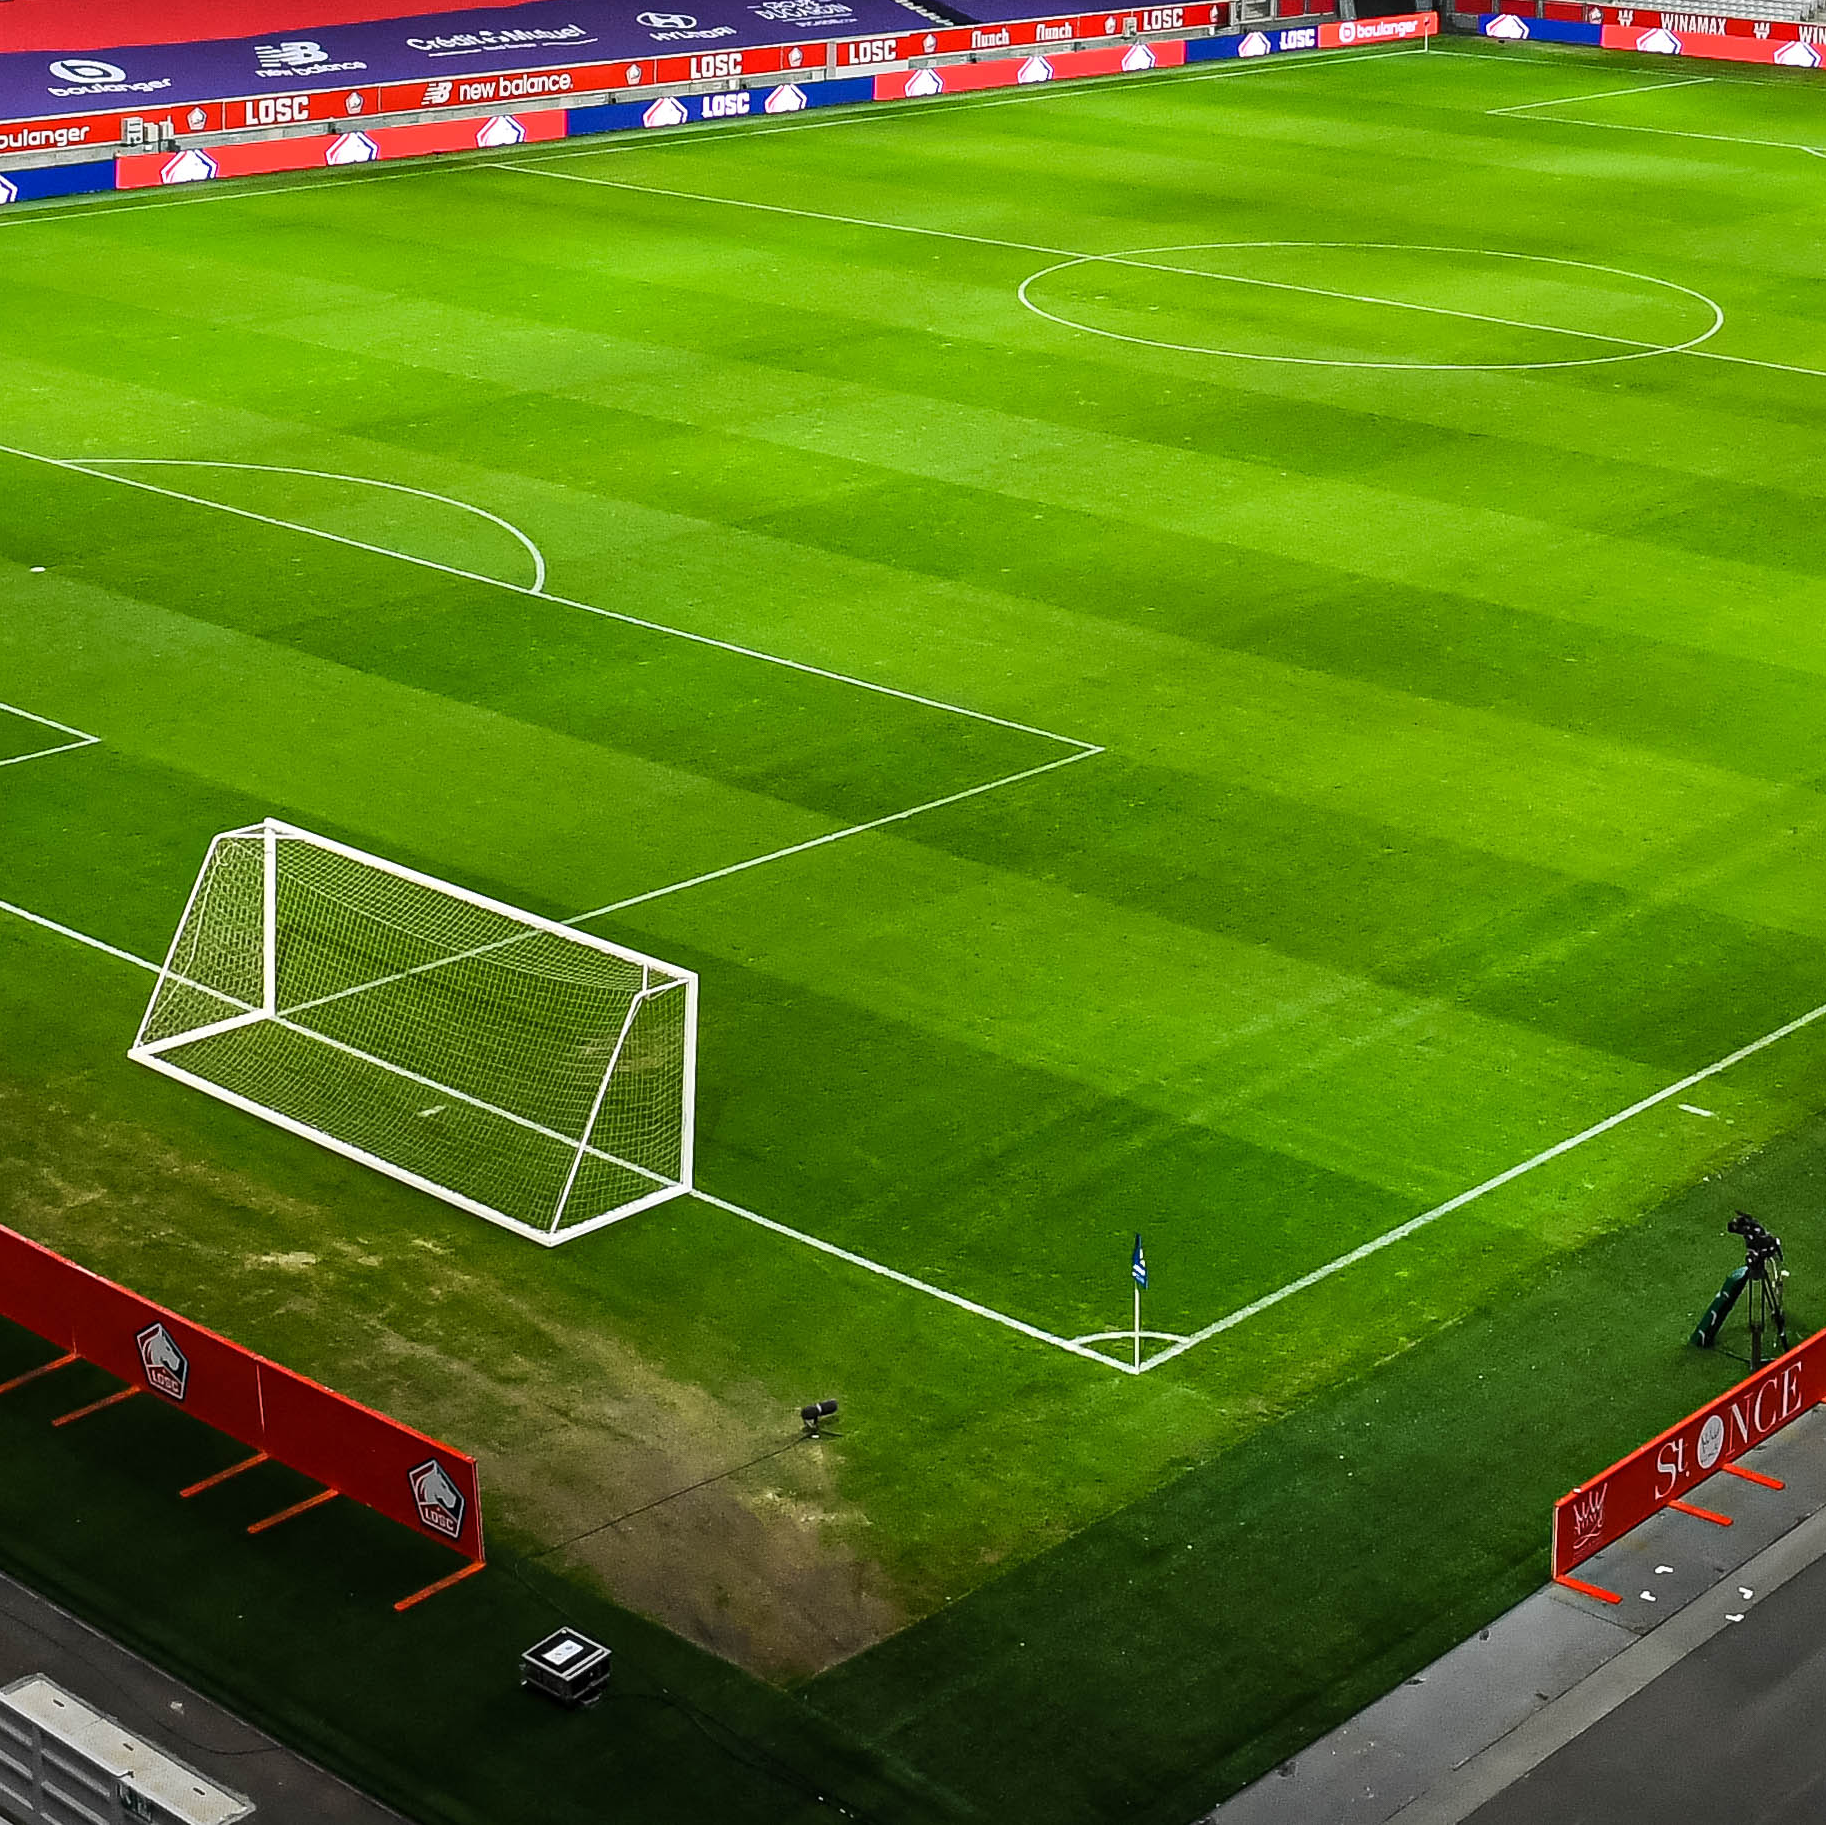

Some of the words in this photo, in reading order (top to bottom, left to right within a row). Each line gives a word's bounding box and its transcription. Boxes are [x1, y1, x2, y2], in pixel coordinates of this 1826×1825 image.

[1143, 8, 1183, 29] LOSC
[1356, 19, 1418, 41] boulanger
[1660, 13, 1726, 36] WINAMAX
[406, 33, 477, 51] Crédit
[502, 24, 586, 43] Mutuel
[649, 26, 737, 42] HYUNDAI
[971, 27, 1010, 49] flunch
[1036, 20, 1072, 42] flunch
[1280, 27, 1315, 50] LOSC
[849, 38, 896, 63] LOSC
[255, 68, 293, 79] new
[296, 60, 367, 76] balance
[690, 54, 742, 79] LOSC
[48, 77, 172, 97] boulanger
[459, 83, 495, 100] new
[499, 72, 573, 95] balance
[245, 97, 308, 125] LOSC
[702, 94, 750, 118] LOSC
[152, 1371, 178, 1393] LOSC
[425, 1508, 453, 1532] LOSC
